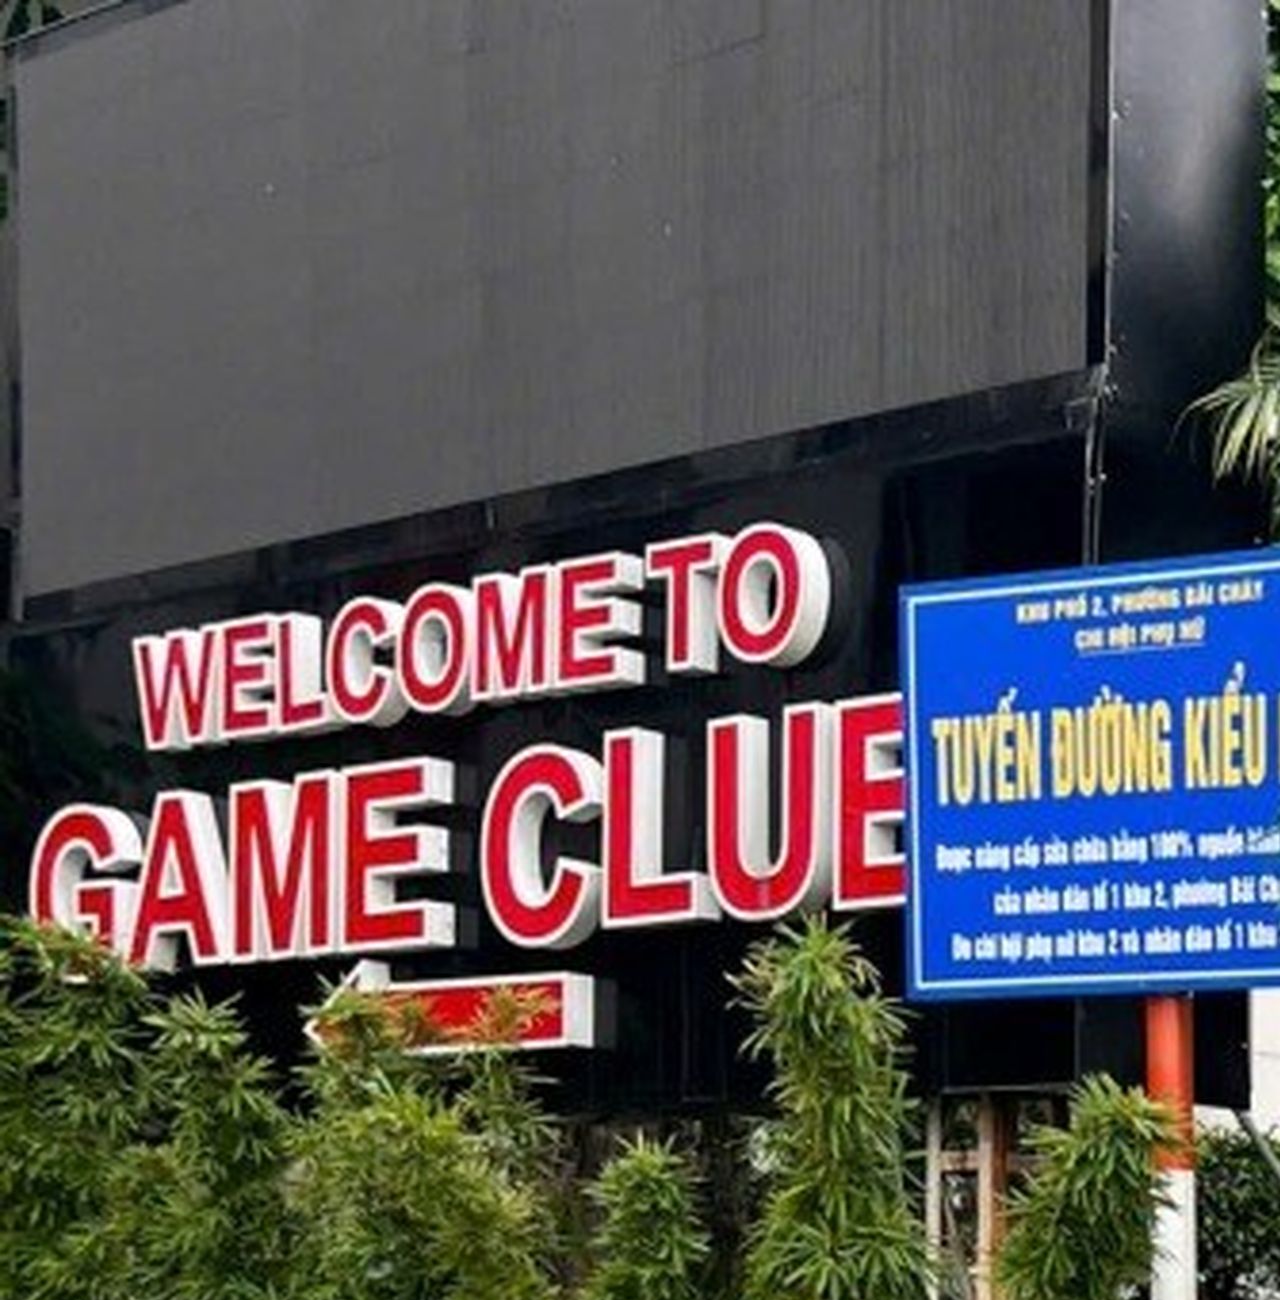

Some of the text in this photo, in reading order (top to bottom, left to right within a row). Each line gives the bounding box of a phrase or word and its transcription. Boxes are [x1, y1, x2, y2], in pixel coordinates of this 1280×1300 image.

[132, 522, 832, 751] WELCOME TO
[931, 686, 1042, 806] TUYẾN
[1050, 685, 1172, 798] ĐƯỜNG
[1184, 661, 1267, 789] KIỂU
[29, 756, 457, 973] GAME
